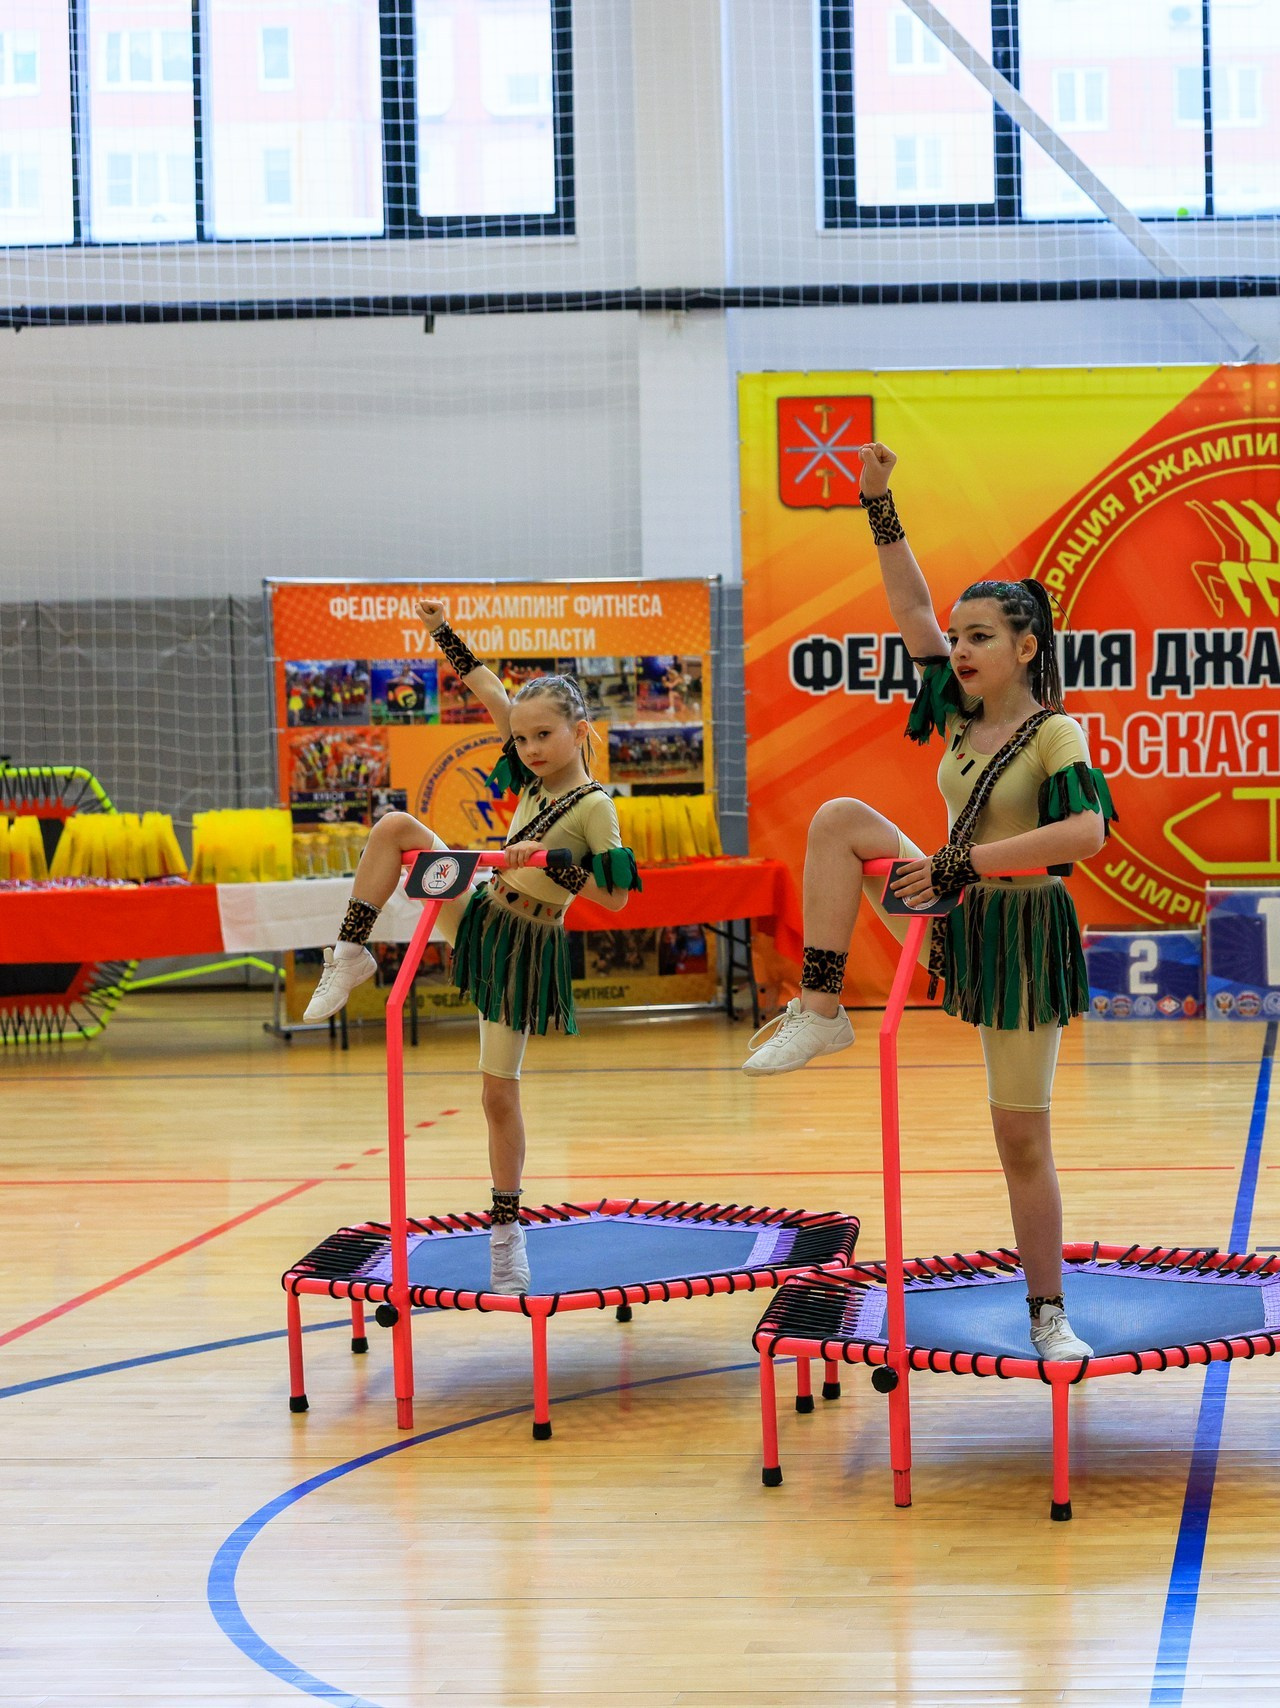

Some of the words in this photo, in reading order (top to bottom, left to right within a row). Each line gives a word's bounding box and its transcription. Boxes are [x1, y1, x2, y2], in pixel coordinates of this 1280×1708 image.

[1045, 493, 1125, 618] ЕРАЦИЯ
[329, 596, 450, 622] ФЕДЕРАЯ
[456, 595, 568, 620] ДЖАМПИНГ
[574, 594, 663, 618] ФИТНЕСА
[402, 625, 503, 653] ТУКОЙ
[509, 628, 596, 652] ОБЛАСТИ
[789, 629, 1135, 703] ФЕДИЯ
[1104, 859, 1205, 924] JUMPI
[1129, 939, 1158, 994] 2
